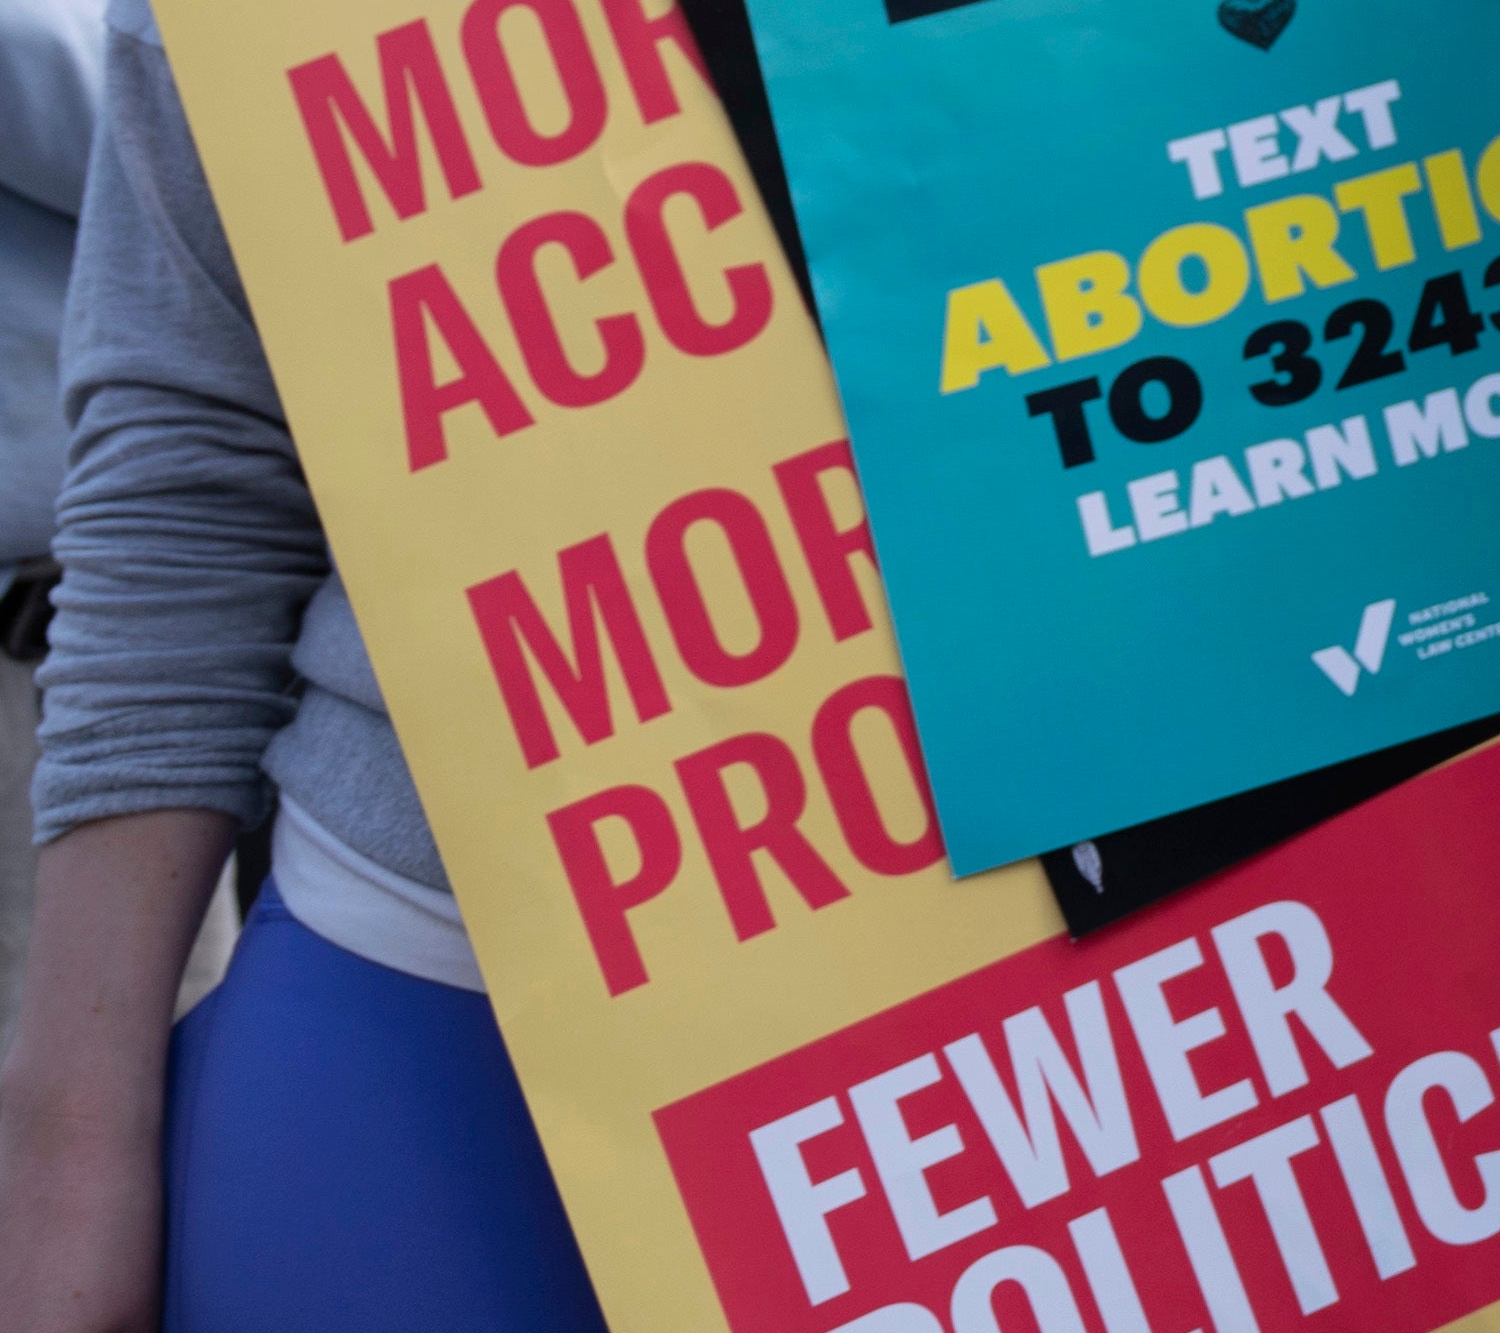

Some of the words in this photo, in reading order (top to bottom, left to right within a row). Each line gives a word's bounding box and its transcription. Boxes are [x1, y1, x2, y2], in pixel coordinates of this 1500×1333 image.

[1166, 77, 1401, 200] TEXT
[1024, 354, 1204, 470] TO
[1076, 414, 1378, 557] LEARN
[748, 900, 1375, 1307] FEWER
